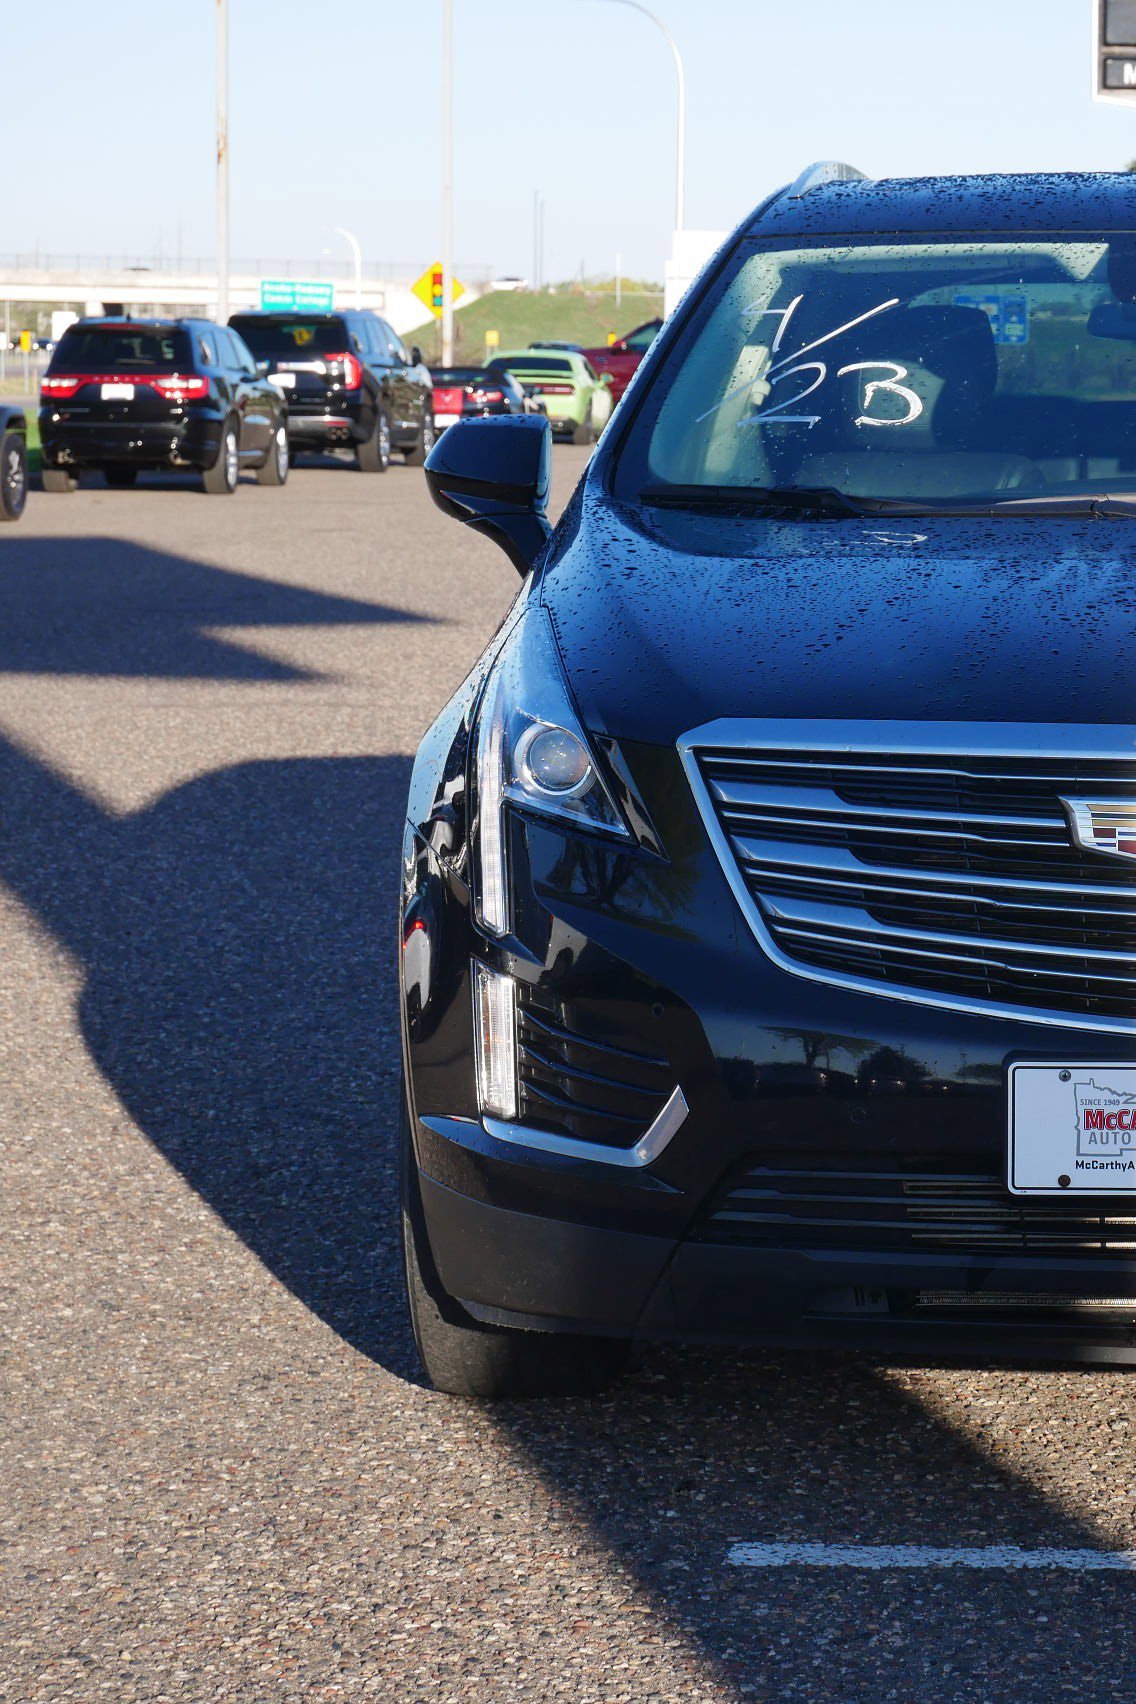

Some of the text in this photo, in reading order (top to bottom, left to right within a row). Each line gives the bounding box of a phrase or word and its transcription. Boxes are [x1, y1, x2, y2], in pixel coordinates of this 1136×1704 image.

[1079, 1098, 1121, 1106] SINCE 1949
[1088, 1131, 1132, 1145] AUTO
